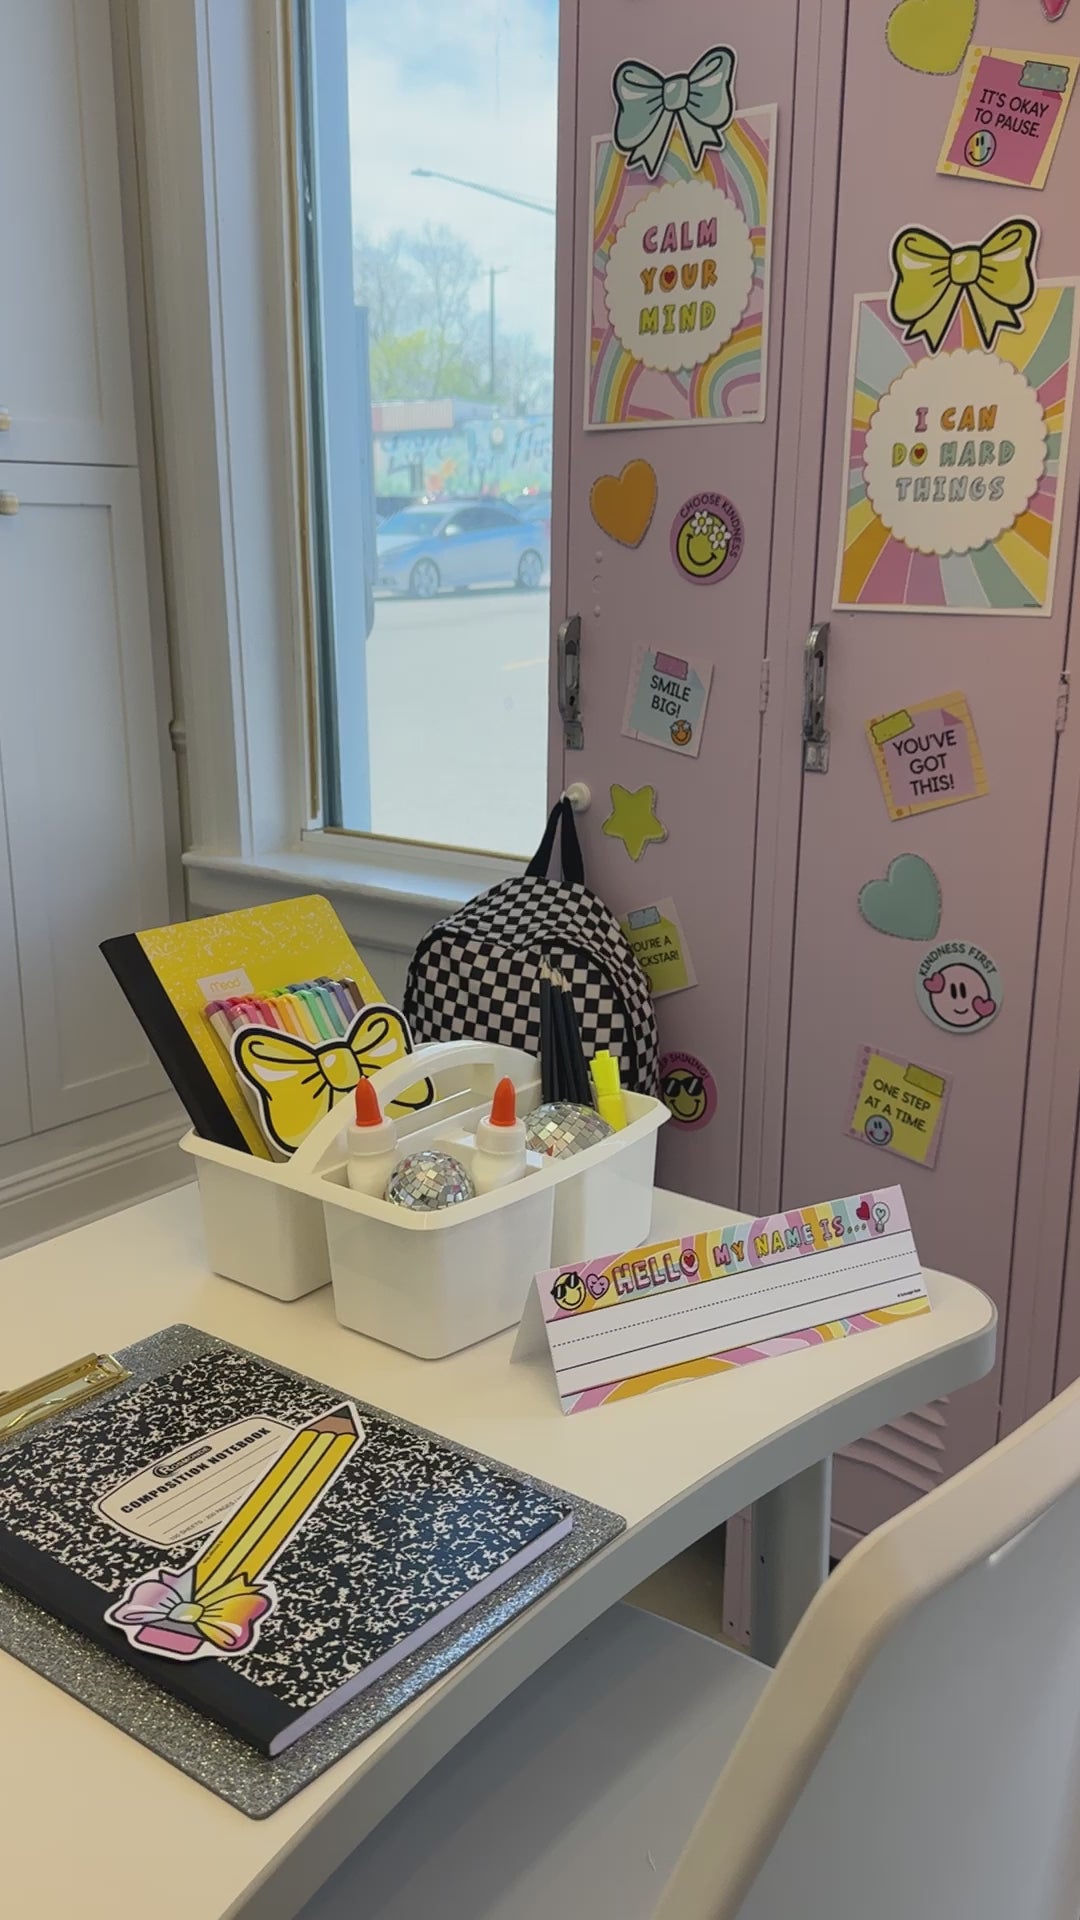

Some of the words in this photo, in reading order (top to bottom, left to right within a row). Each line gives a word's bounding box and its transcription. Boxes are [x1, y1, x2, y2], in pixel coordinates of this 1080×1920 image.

[980, 88, 1007, 108] IT'S
[1009, 96, 1050, 118] OKAY
[974, 107, 993, 125] TO
[994, 112, 1041, 138] PAUSE.
[642, 216, 718, 254] CALM
[640, 258, 719, 295] YOUR
[638, 300, 716, 336] MIND
[914, 406, 929, 433] I
[940, 404, 999, 432] CAN
[891, 441, 929, 468] DO
[938, 439, 1016, 467] HARD
[895, 475, 1006, 502] THINGS
[680, 493, 722, 519] CHOOSE
[721, 500, 742, 558] KINDNESS
[649, 674, 692, 702] SMILE
[651, 694, 682, 719] BIG!
[891, 729, 958, 757] YOU'VE
[909, 752, 948, 775] GOT
[909, 773, 956, 797] THIS!
[632, 936, 662, 953] OU'RE
[663, 935, 673, 946] A
[639, 949, 681, 968] CKSTAR!
[918, 942, 967, 977] KINDNESS
[967, 946, 998, 974] FIRST
[873, 1078, 901, 1100] ONE
[901, 1091, 932, 1112] STEP
[864, 1095, 882, 1109] AT
[881, 1103, 892, 1116] A
[895, 1107, 927, 1133] TIME.
[611, 1248, 700, 1297] HELLO
[712, 1240, 745, 1268] MY
[753, 1222, 815, 1260] NAME
[120, 1463, 210, 1514] COMPOSITION
[208, 1426, 272, 1465] NOTEBOOK
